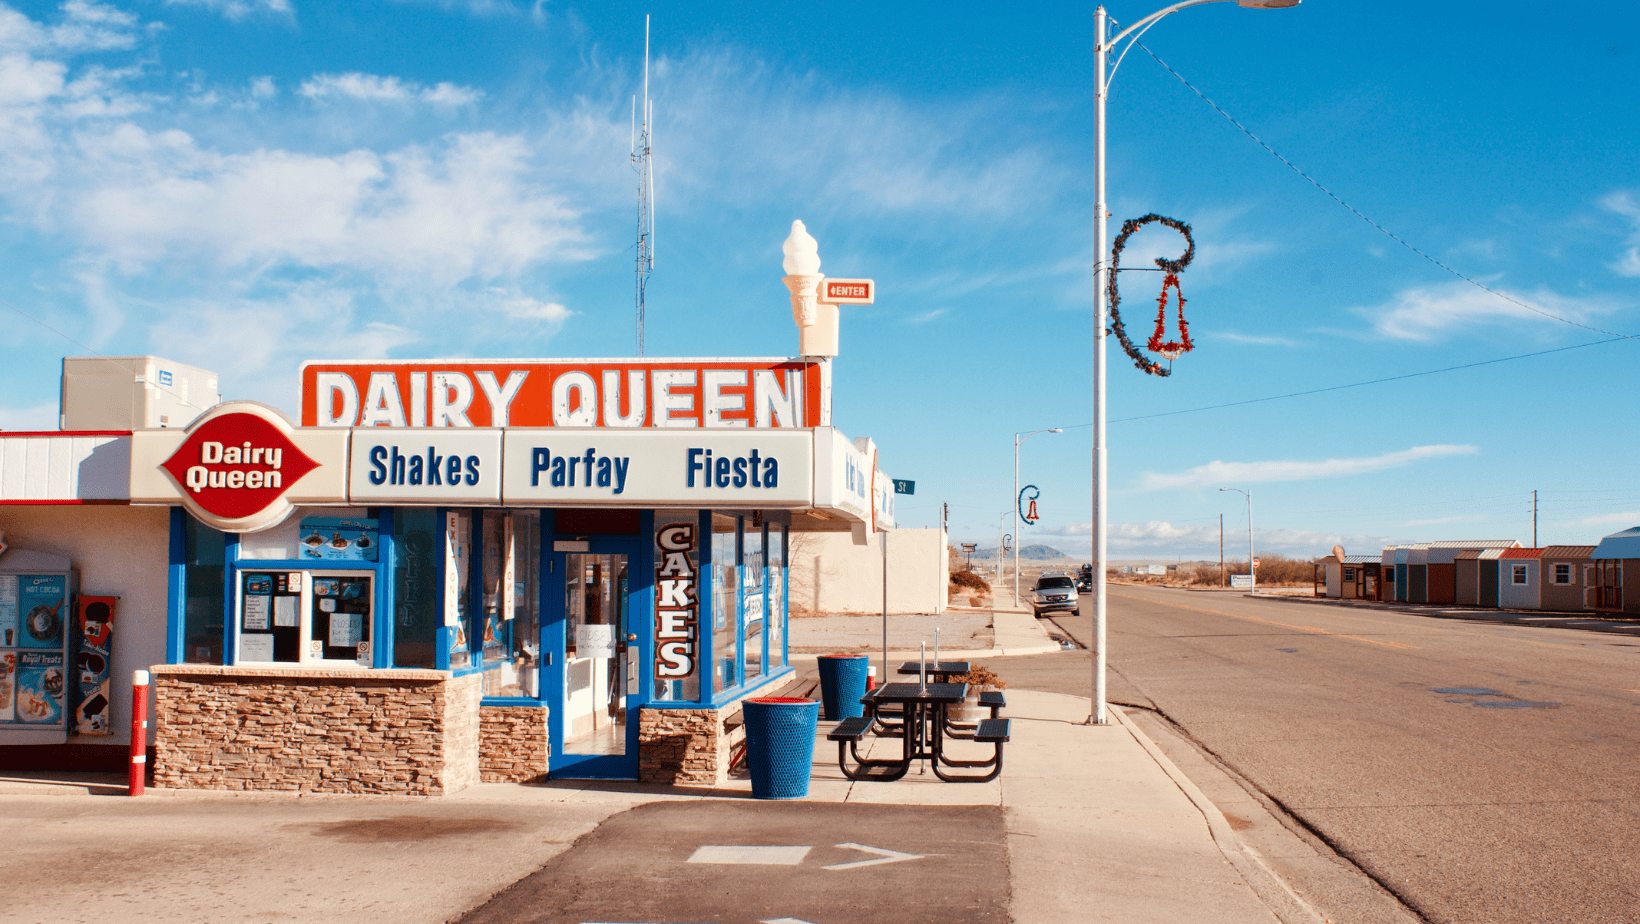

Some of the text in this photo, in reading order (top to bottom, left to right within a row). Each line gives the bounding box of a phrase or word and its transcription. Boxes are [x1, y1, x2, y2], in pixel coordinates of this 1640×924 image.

[835, 285, 866, 297] ENTER
[316, 369, 804, 428] DAIRY QUEEN
[202, 441, 282, 468] Dairy
[369, 445, 481, 487] Shakes
[186, 465, 282, 492] Queen
[531, 447, 779, 495] Parfay Fiesta
[897, 481, 907, 493] St
[656, 523, 700, 680] CAKES
[21, 654, 63, 665] Royal Treats
[83, 684, 102, 697] Treats
